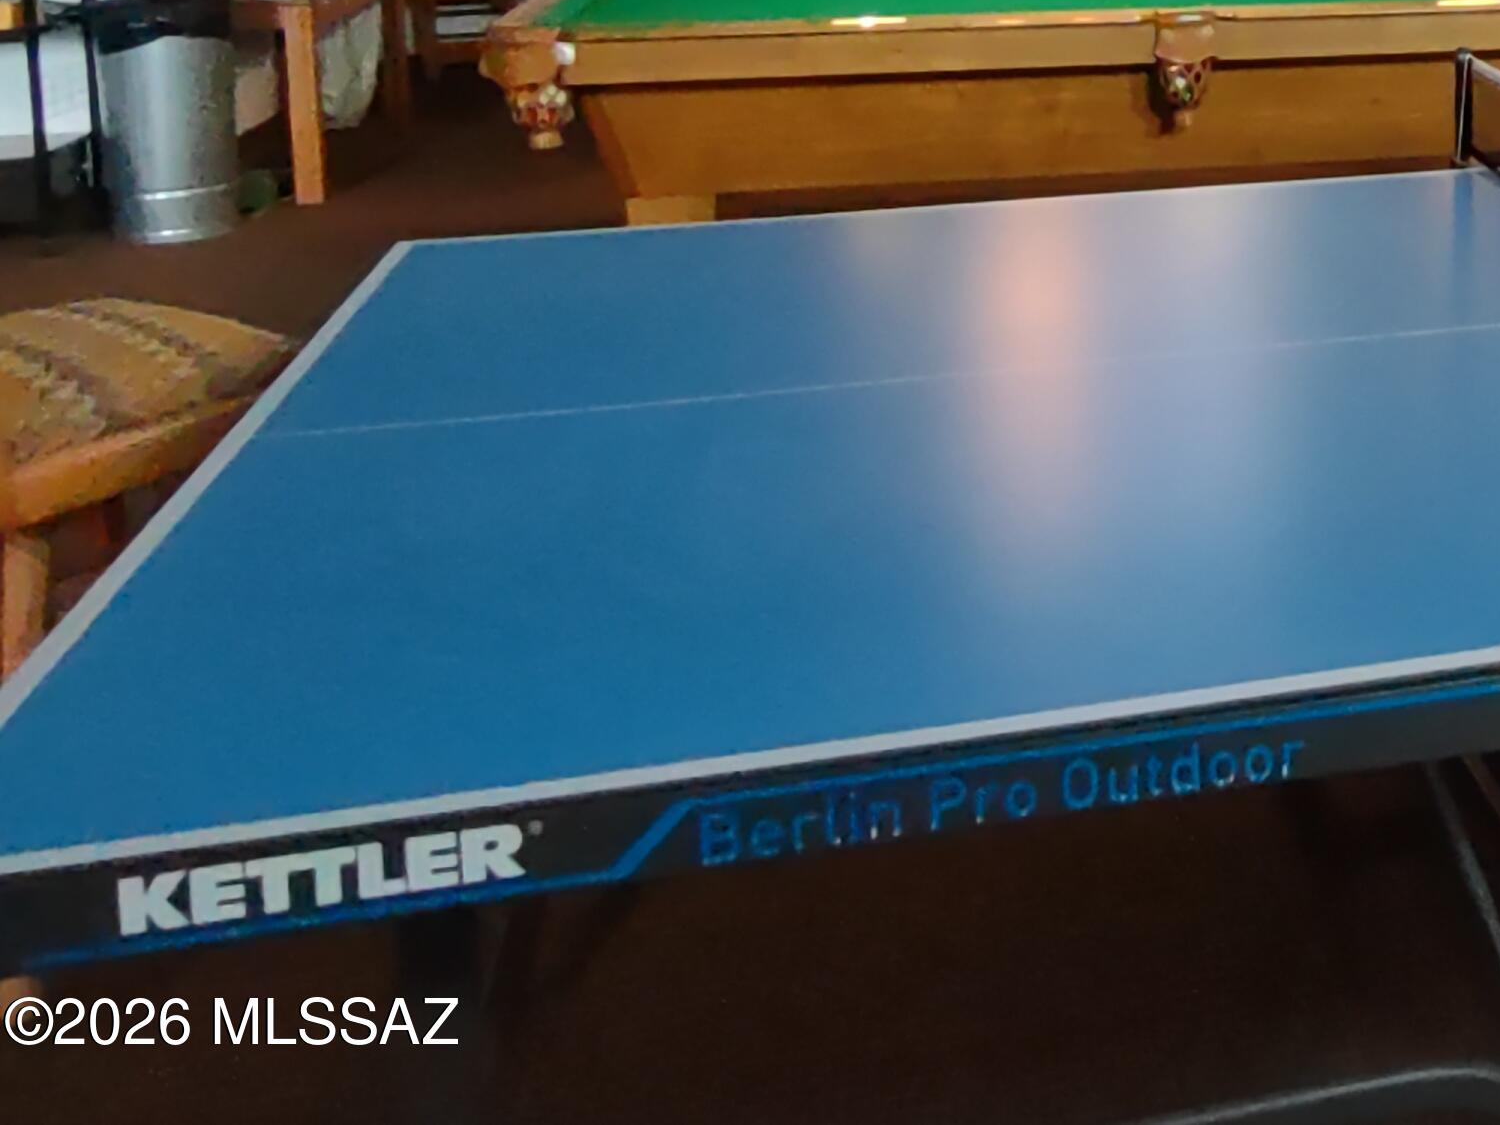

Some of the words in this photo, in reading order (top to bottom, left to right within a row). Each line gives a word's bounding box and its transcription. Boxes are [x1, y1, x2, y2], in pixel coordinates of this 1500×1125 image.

[699, 789, 903, 866] Berlin
[926, 776, 1038, 832] Pro
[1060, 739, 1305, 811] Outdoor
[117, 823, 526, 936] KETTLER
